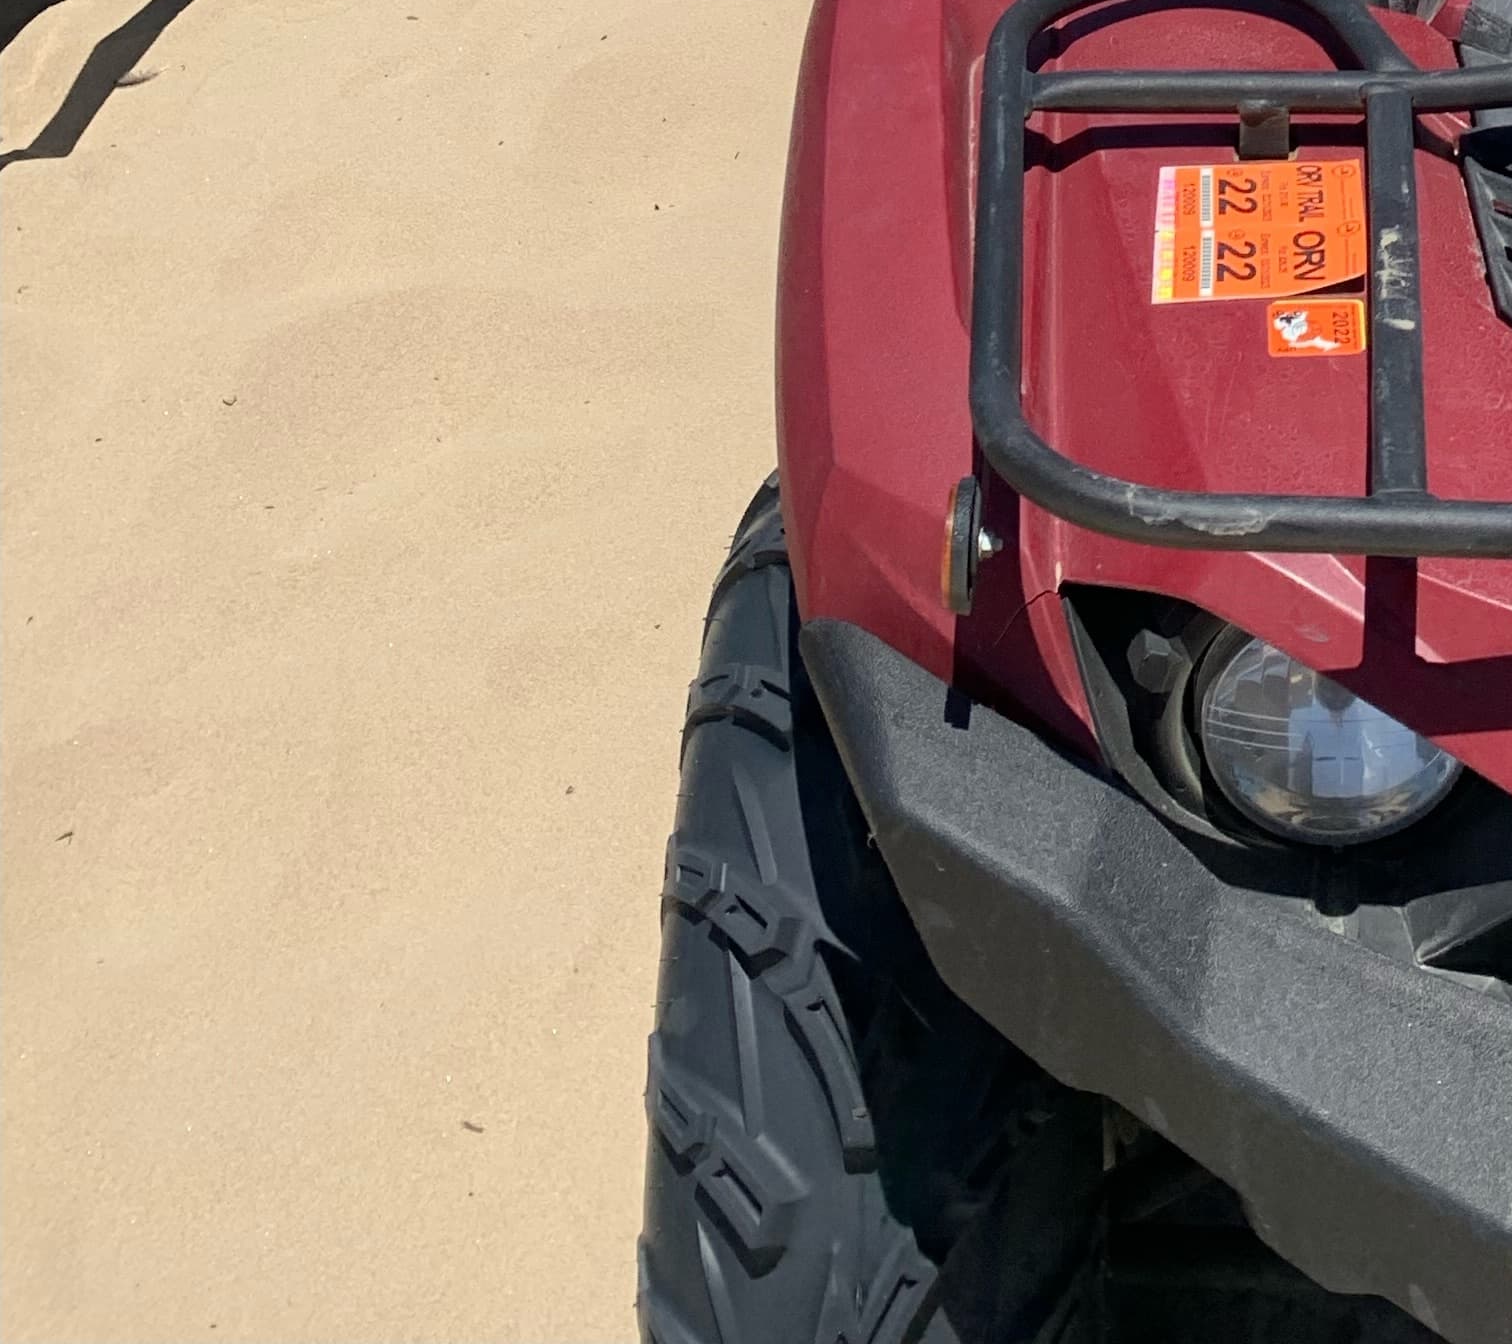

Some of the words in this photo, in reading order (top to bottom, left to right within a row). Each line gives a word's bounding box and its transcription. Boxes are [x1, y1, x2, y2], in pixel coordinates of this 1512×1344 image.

[1296, 165, 1323, 189] ORV
[1218, 178, 1258, 216] 22
[1298, 189, 1325, 223] TRAIL
[1216, 241, 1257, 283] 22
[1292, 230, 1326, 282] ORV
[1333, 311, 1350, 344] 2022
